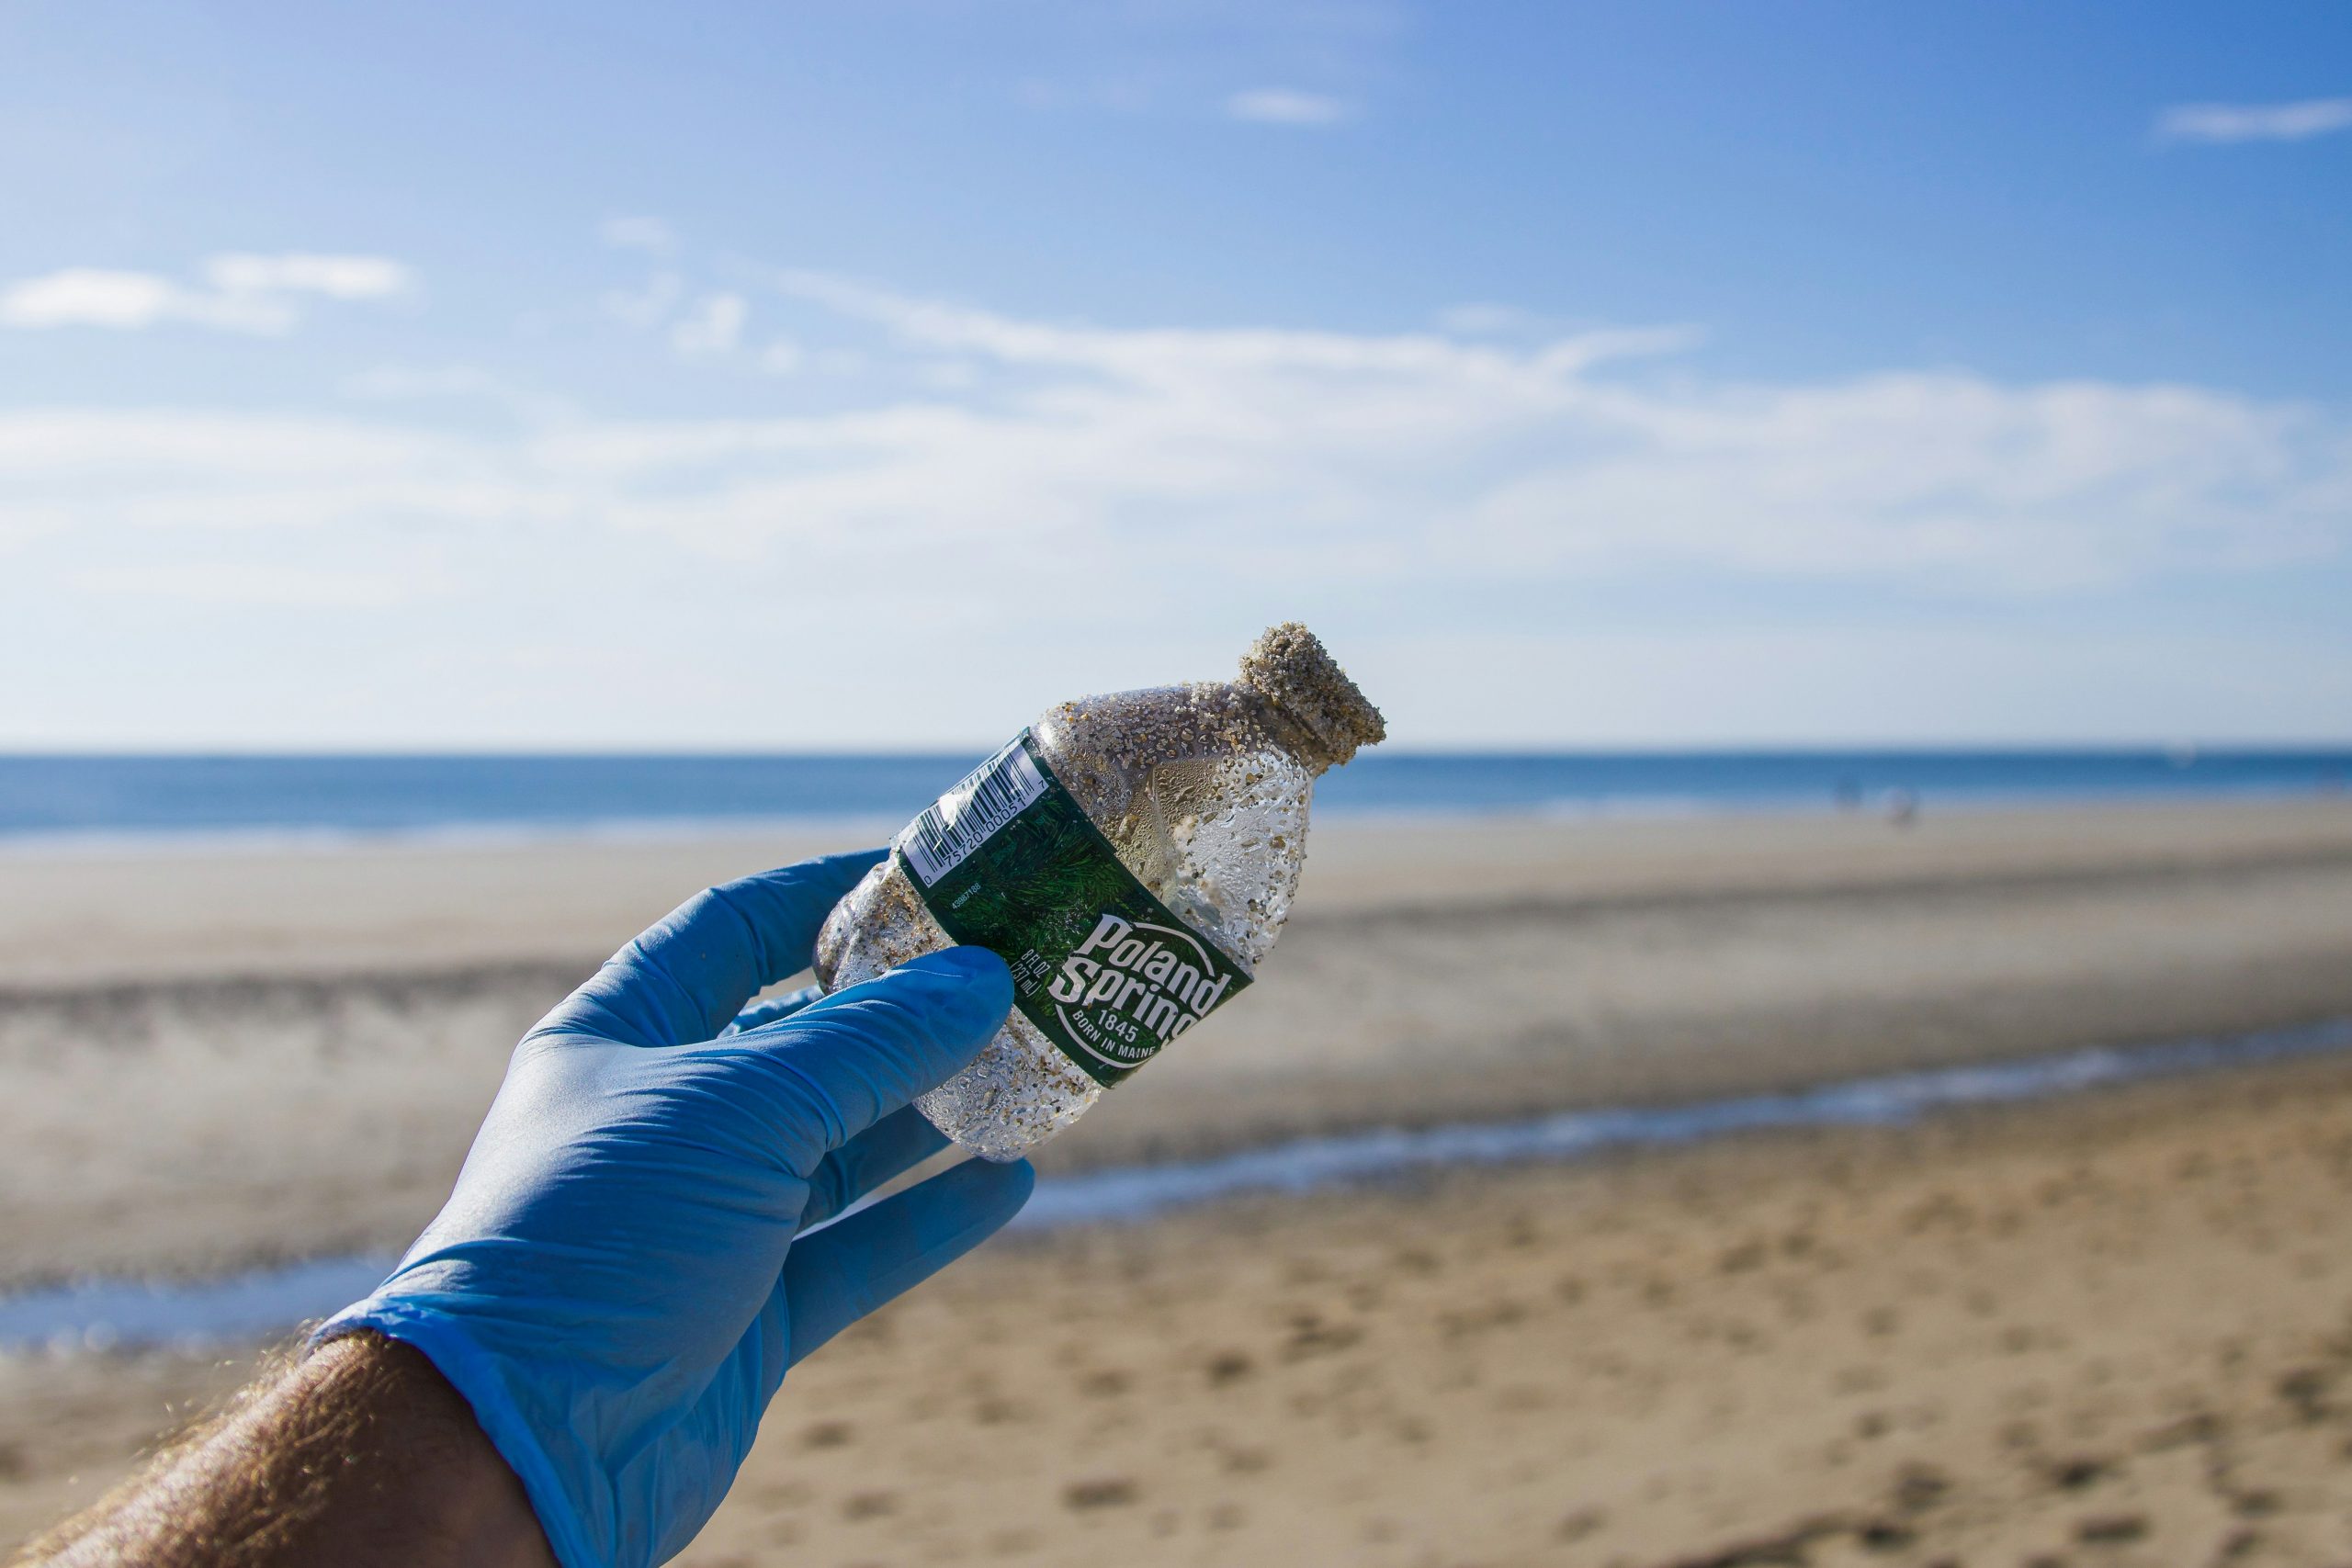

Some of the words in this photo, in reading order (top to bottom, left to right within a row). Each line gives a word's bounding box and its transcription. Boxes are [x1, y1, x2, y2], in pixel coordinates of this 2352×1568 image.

[923, 875, 933, 885] 0
[944, 831, 983, 867] 75720
[987, 797, 1026, 832] 00051
[1038, 780, 1046, 789] 7
[1021, 948, 1035, 961] 8
[1025, 953, 1040, 969] FL
[1033, 961, 1051, 978] OZ
[1073, 913, 1231, 1018] Poland
[1009, 960, 1030, 983] (237
[1020, 978, 1042, 998] mL)
[1072, 1010, 1101, 1042] BORN
[1101, 1037, 1115, 1052] IN
[1117, 1044, 1156, 1058] MAINE
[1098, 1010, 1138, 1043] 1845
